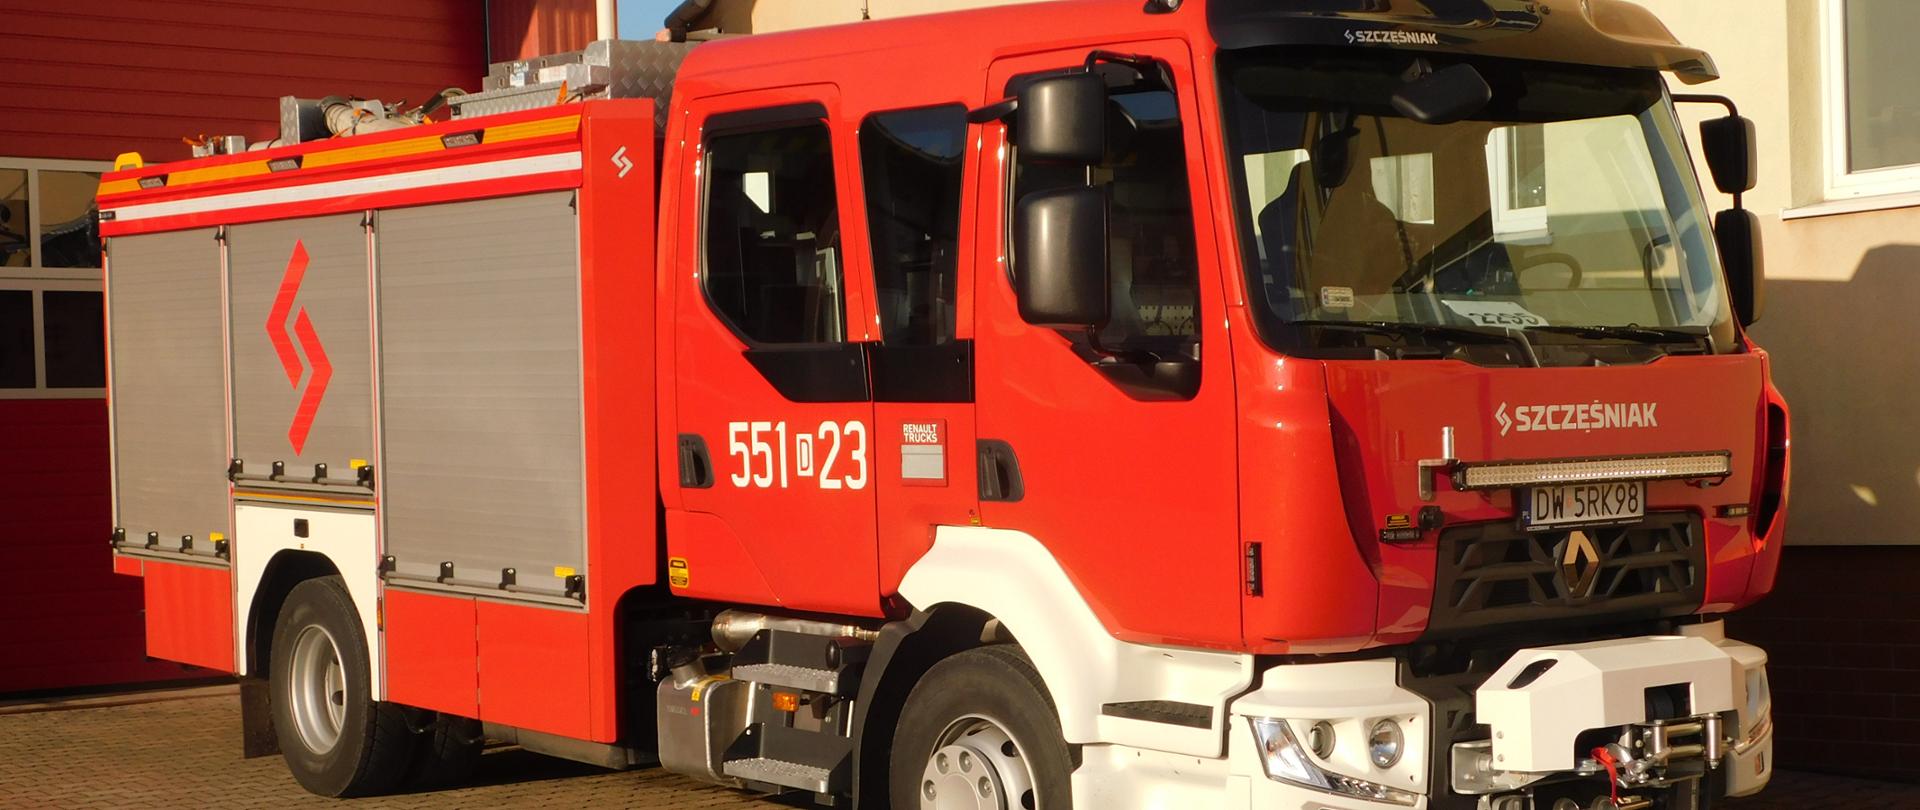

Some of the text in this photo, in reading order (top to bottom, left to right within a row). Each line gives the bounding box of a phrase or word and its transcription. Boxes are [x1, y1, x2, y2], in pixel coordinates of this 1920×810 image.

[1355, 30, 1438, 45] SZCZĘŚNIAK
[903, 423, 937, 433] RENAULT
[1515, 400, 1658, 433] SZCZĘŚNIAK
[904, 432, 938, 443] TRUCKS
[729, 421, 788, 488] 551
[818, 420, 867, 490] 23
[1536, 483, 1639, 521] DW 5RK98
